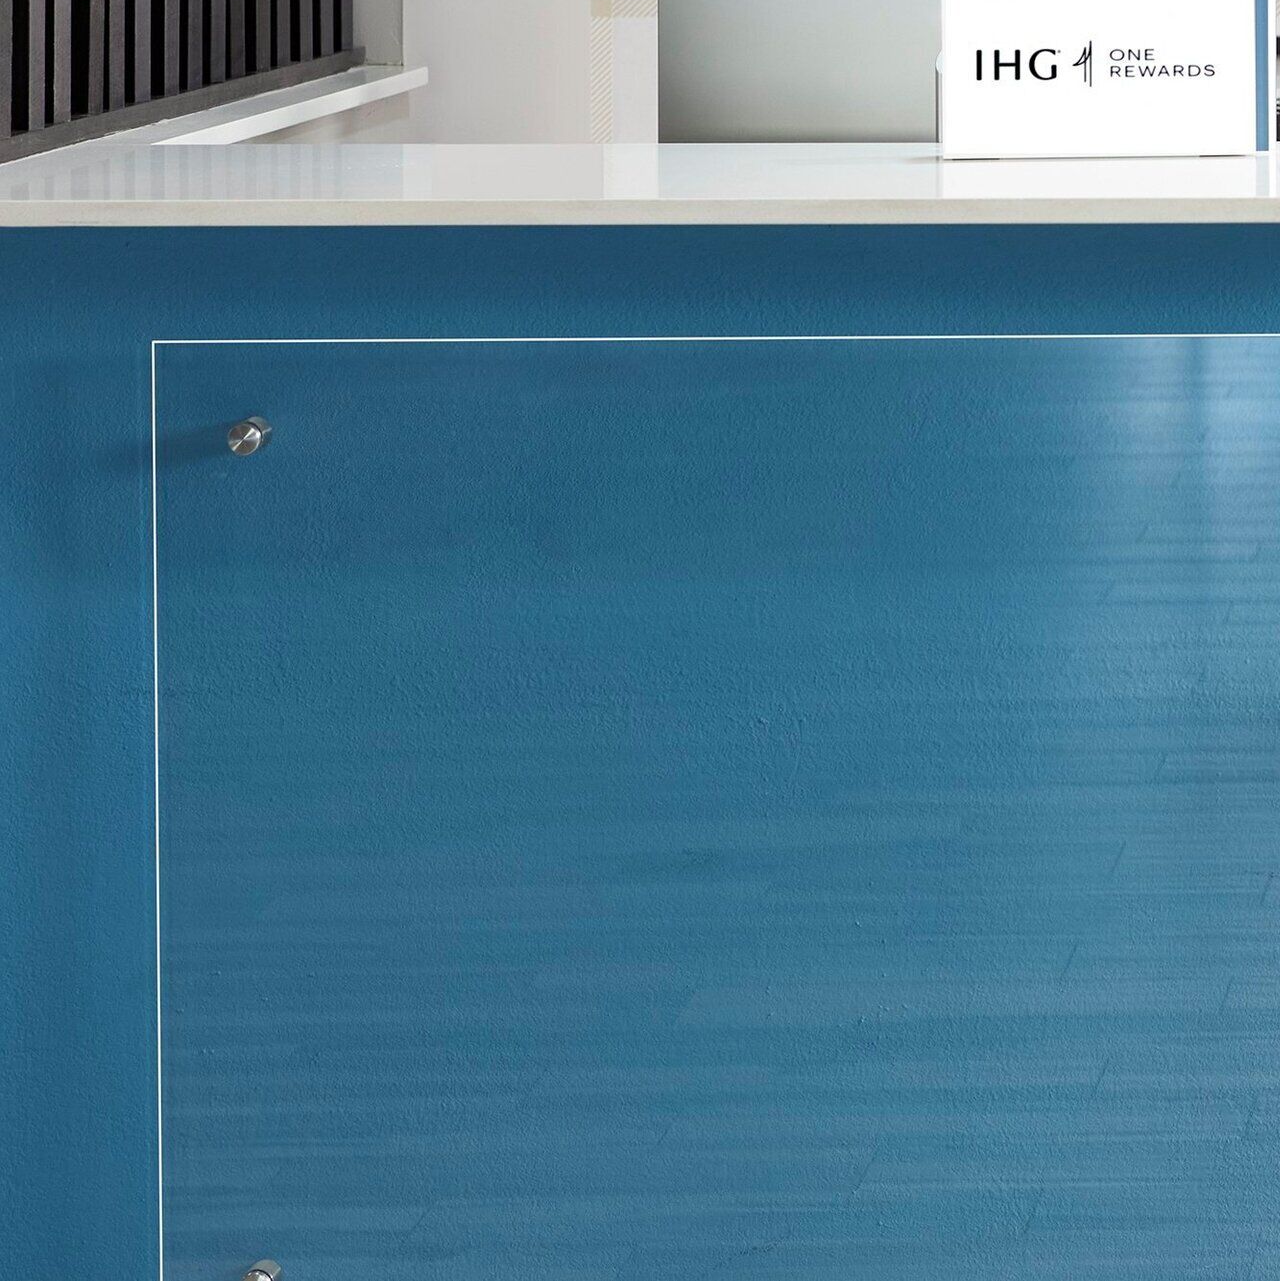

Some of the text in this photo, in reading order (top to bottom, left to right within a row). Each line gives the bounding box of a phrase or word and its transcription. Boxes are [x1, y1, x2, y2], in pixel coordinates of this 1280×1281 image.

[1109, 48, 1155, 61] ONE
[975, 48, 1059, 81] IHG
[1109, 64, 1216, 78] REWARDS
